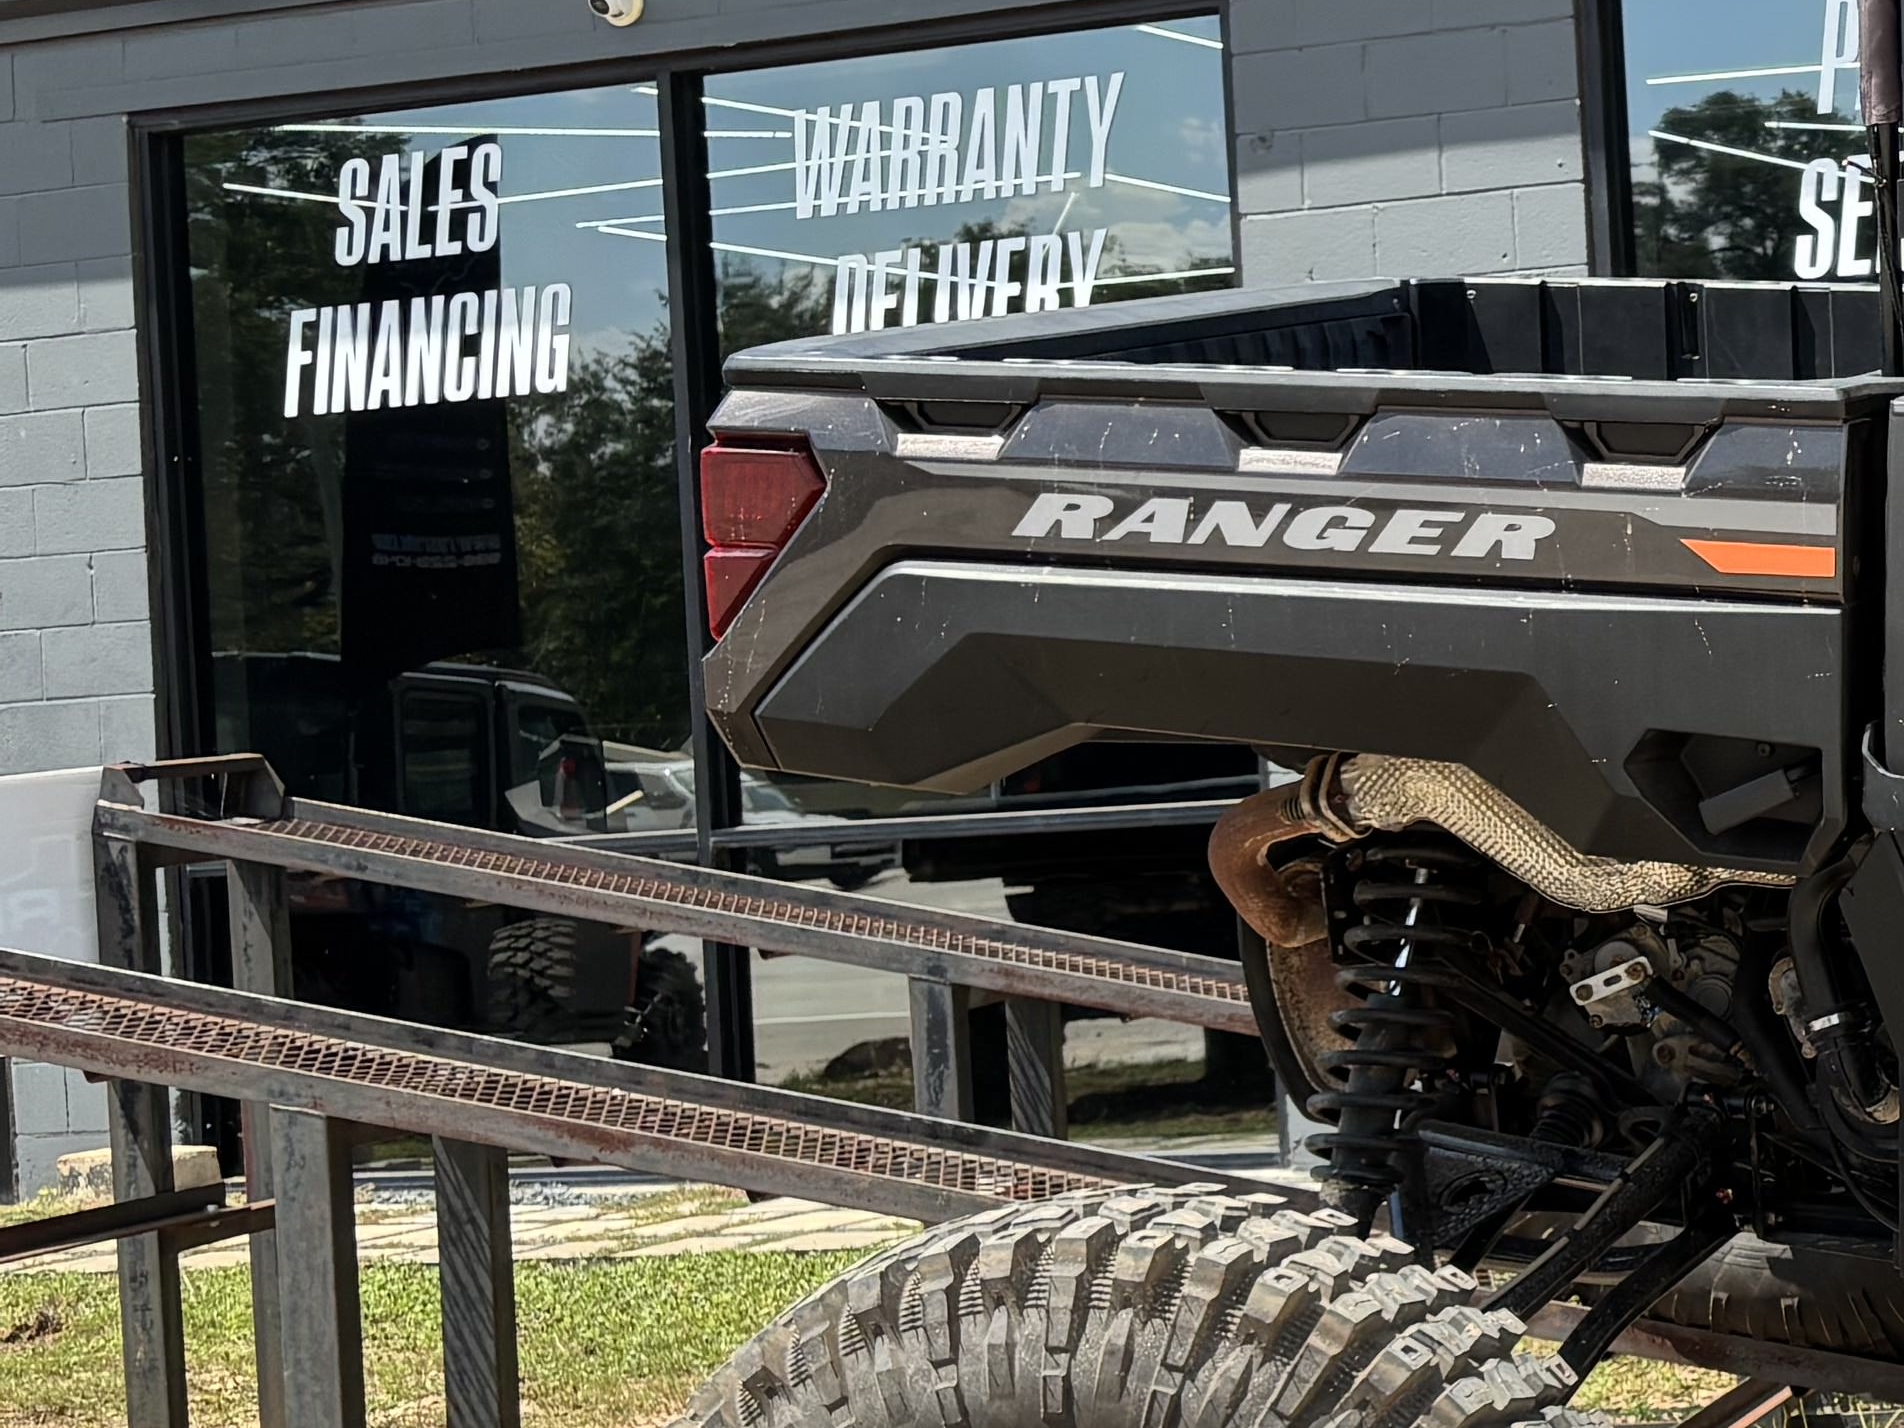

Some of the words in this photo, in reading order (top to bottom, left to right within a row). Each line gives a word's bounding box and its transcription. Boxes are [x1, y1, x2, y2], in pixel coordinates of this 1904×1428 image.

[335, 143, 502, 266] SALES
[794, 72, 1124, 219] WARRANTY
[1794, 154, 1880, 279] SE
[832, 228, 1108, 335] DELIVERY
[284, 283, 571, 418] FINANCING
[1012, 493, 1556, 560] RANGER
